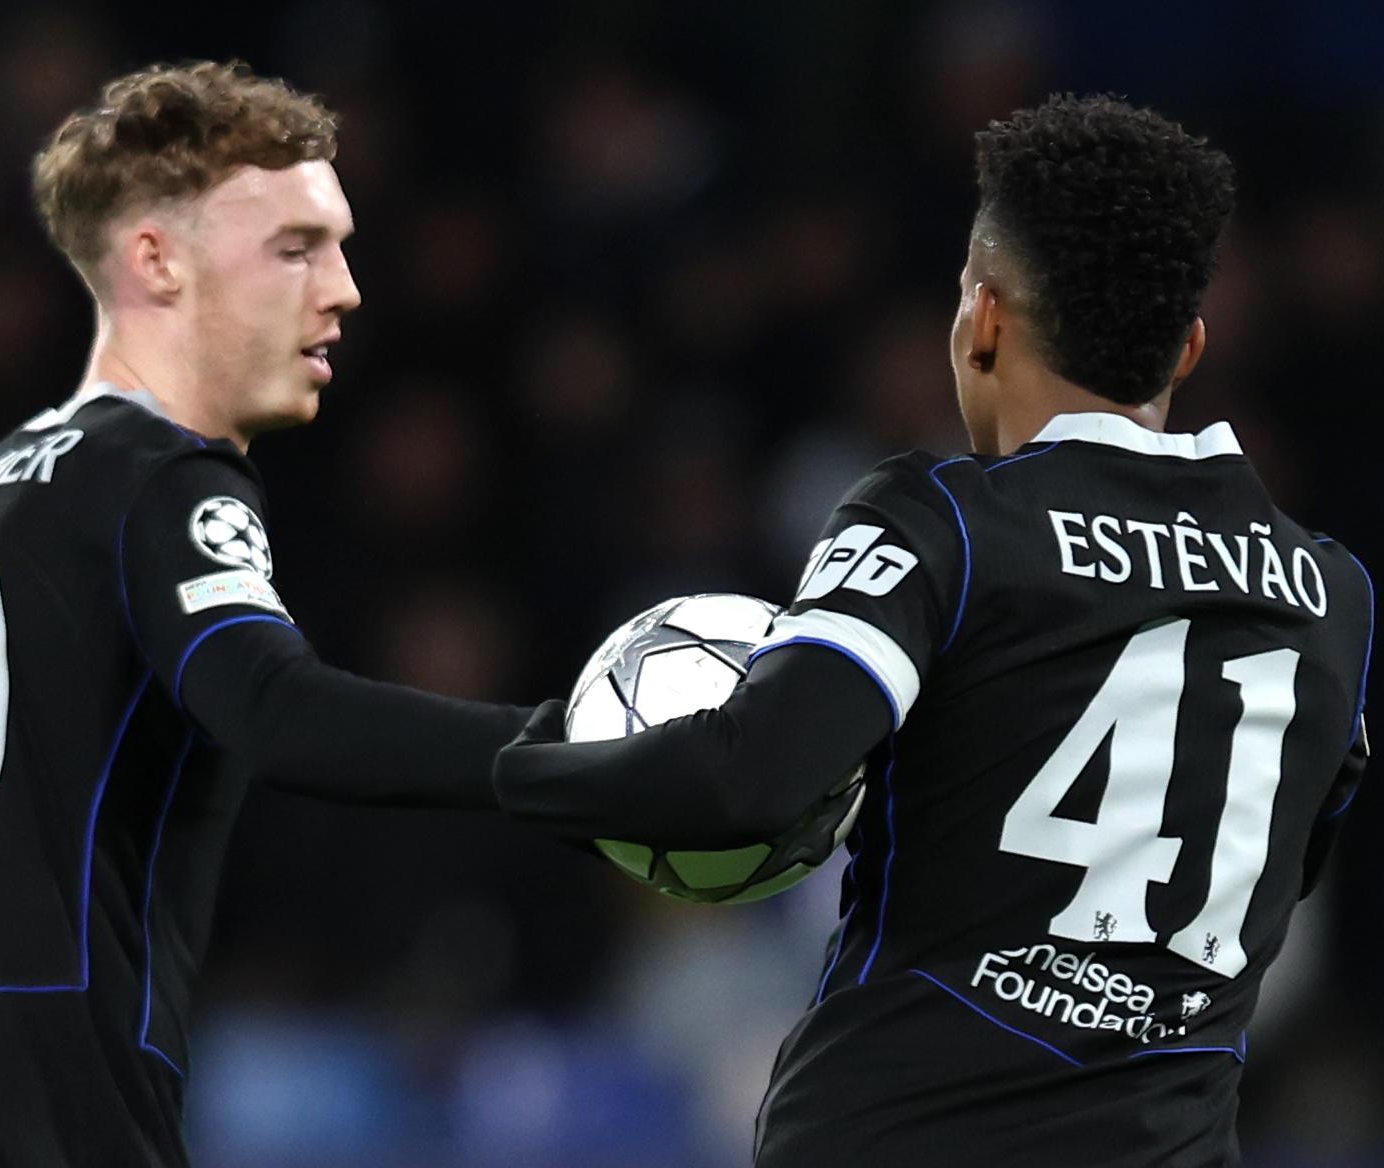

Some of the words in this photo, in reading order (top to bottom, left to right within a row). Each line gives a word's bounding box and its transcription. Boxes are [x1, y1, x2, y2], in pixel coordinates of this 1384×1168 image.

[1047, 510, 1327, 618] ESTÊVÃO
[998, 618, 1302, 979] 41
[971, 953, 1186, 1043] Foundatio
